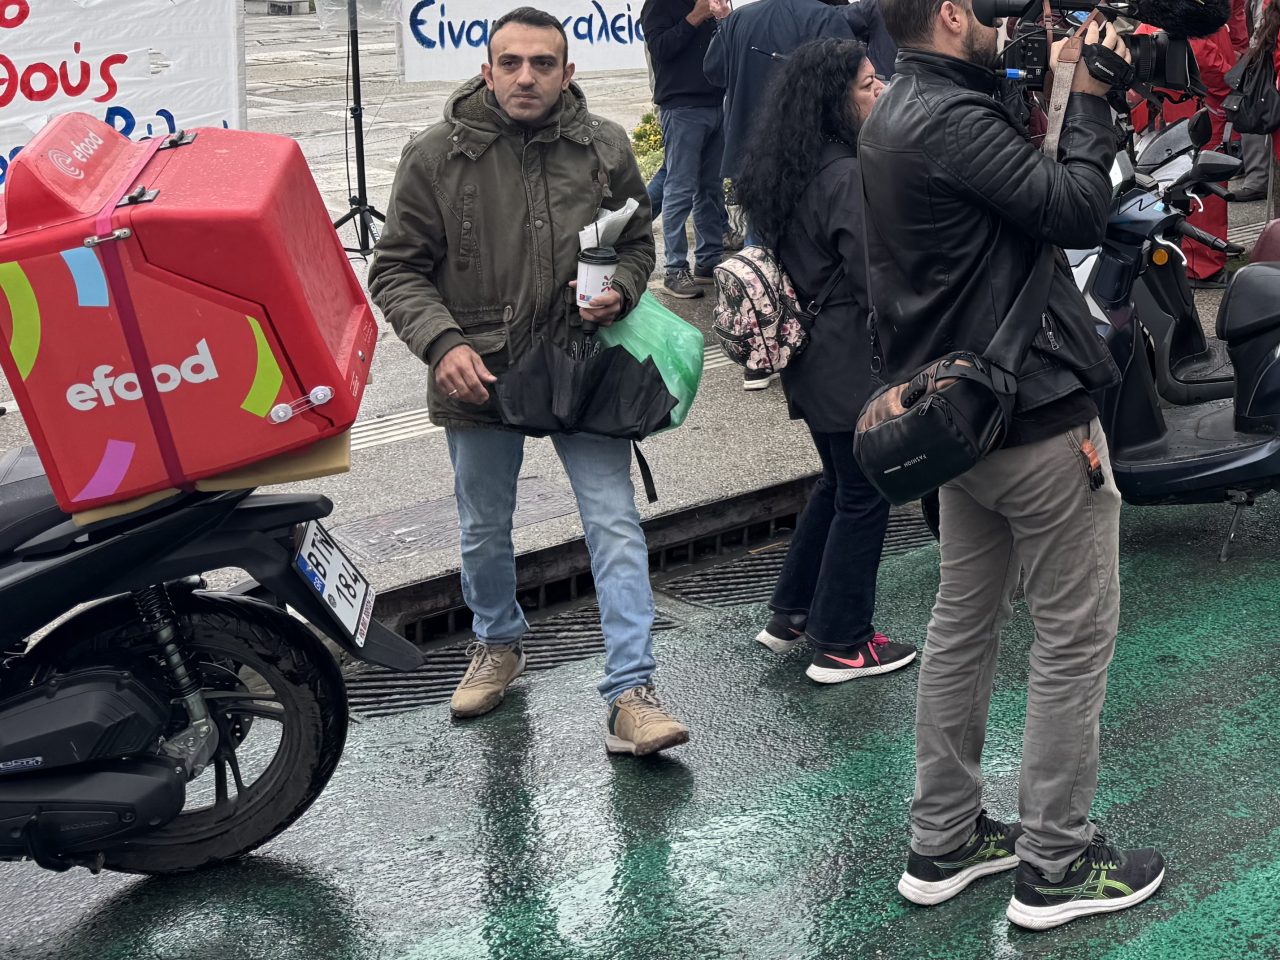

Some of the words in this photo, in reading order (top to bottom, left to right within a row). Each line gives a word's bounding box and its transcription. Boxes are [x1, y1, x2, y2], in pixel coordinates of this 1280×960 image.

[71, 128, 105, 164] efood
[66, 337, 219, 412] efood
[335, 562, 361, 609] 184
